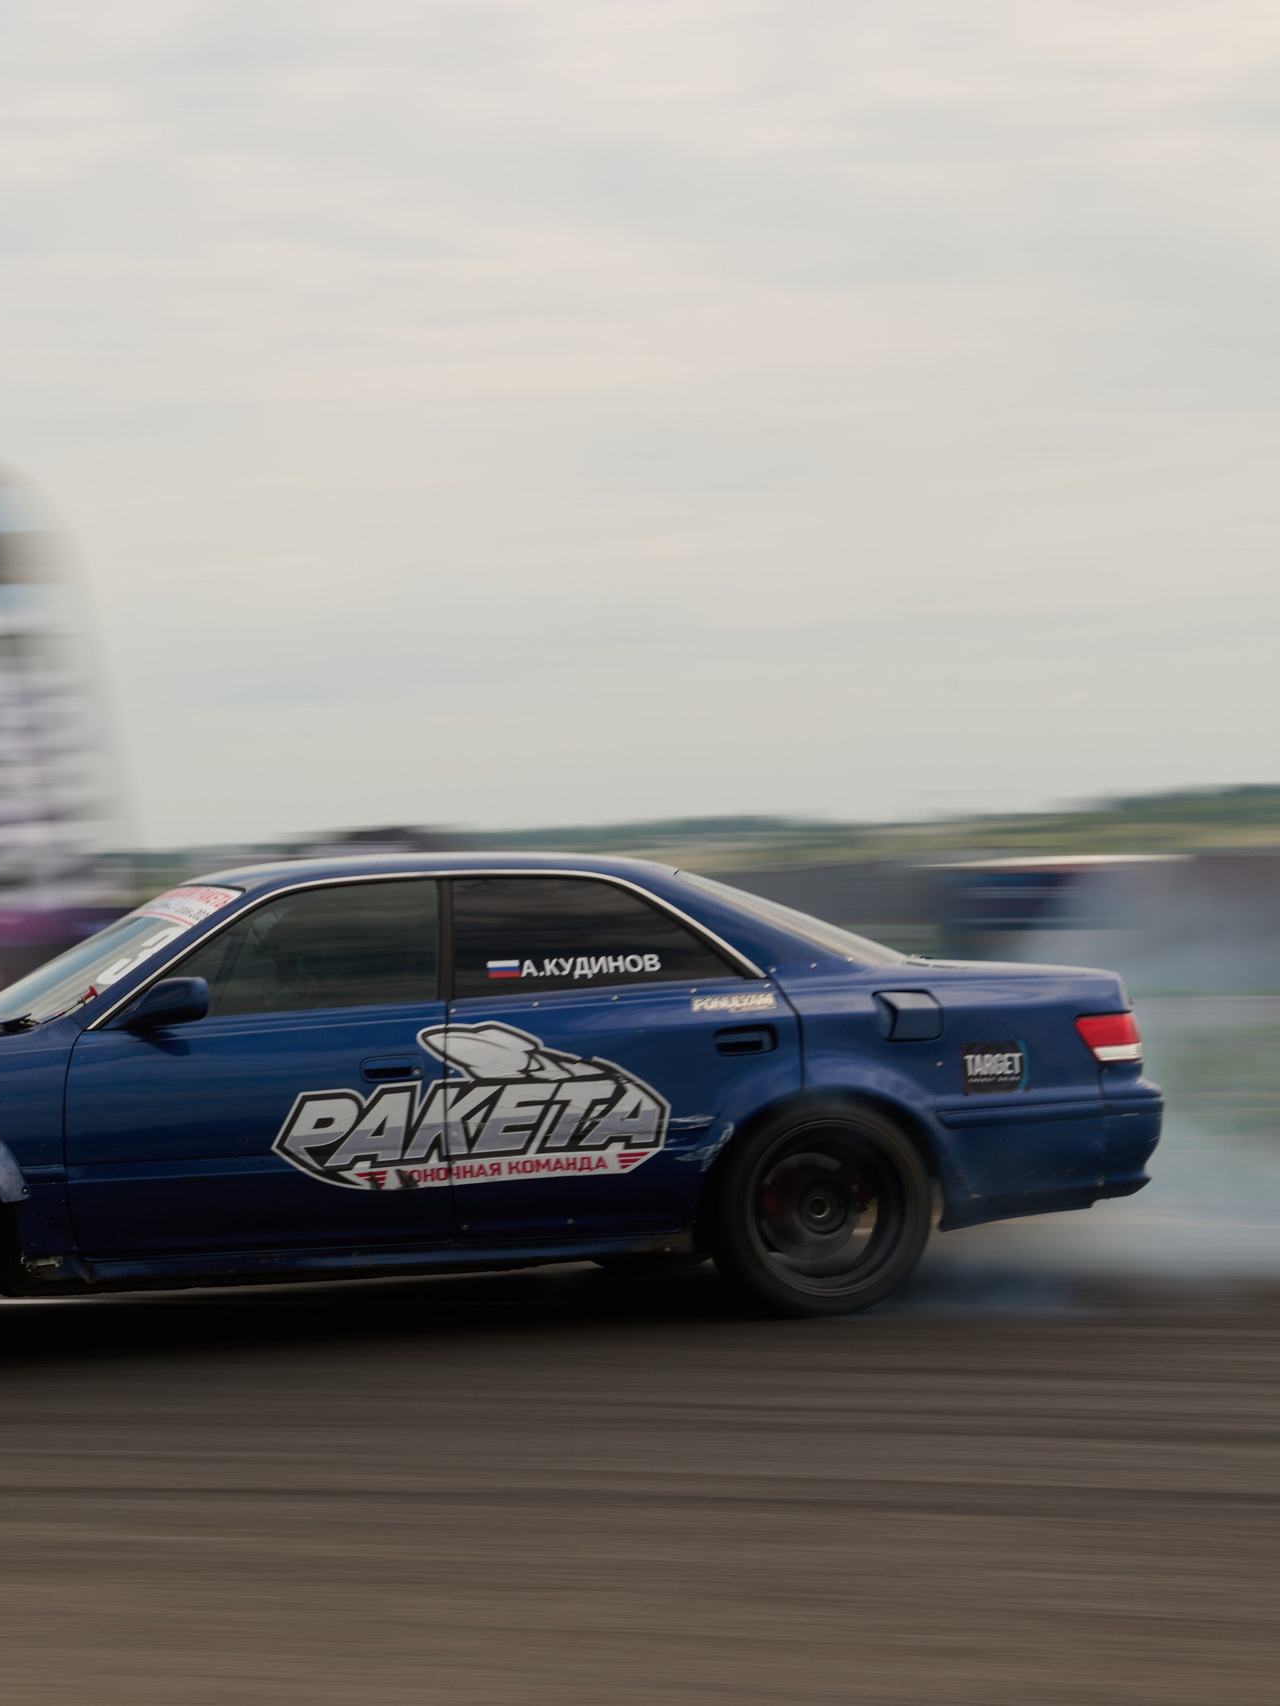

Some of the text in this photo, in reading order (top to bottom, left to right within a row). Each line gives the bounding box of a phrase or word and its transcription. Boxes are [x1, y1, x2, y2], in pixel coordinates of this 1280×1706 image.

[521, 953, 662, 980] А.КУДИНОВ
[963, 1052, 1024, 1076] TARGET
[282, 1080, 658, 1172] РАКЕТА
[507, 1154, 608, 1176] КОМАНДА
